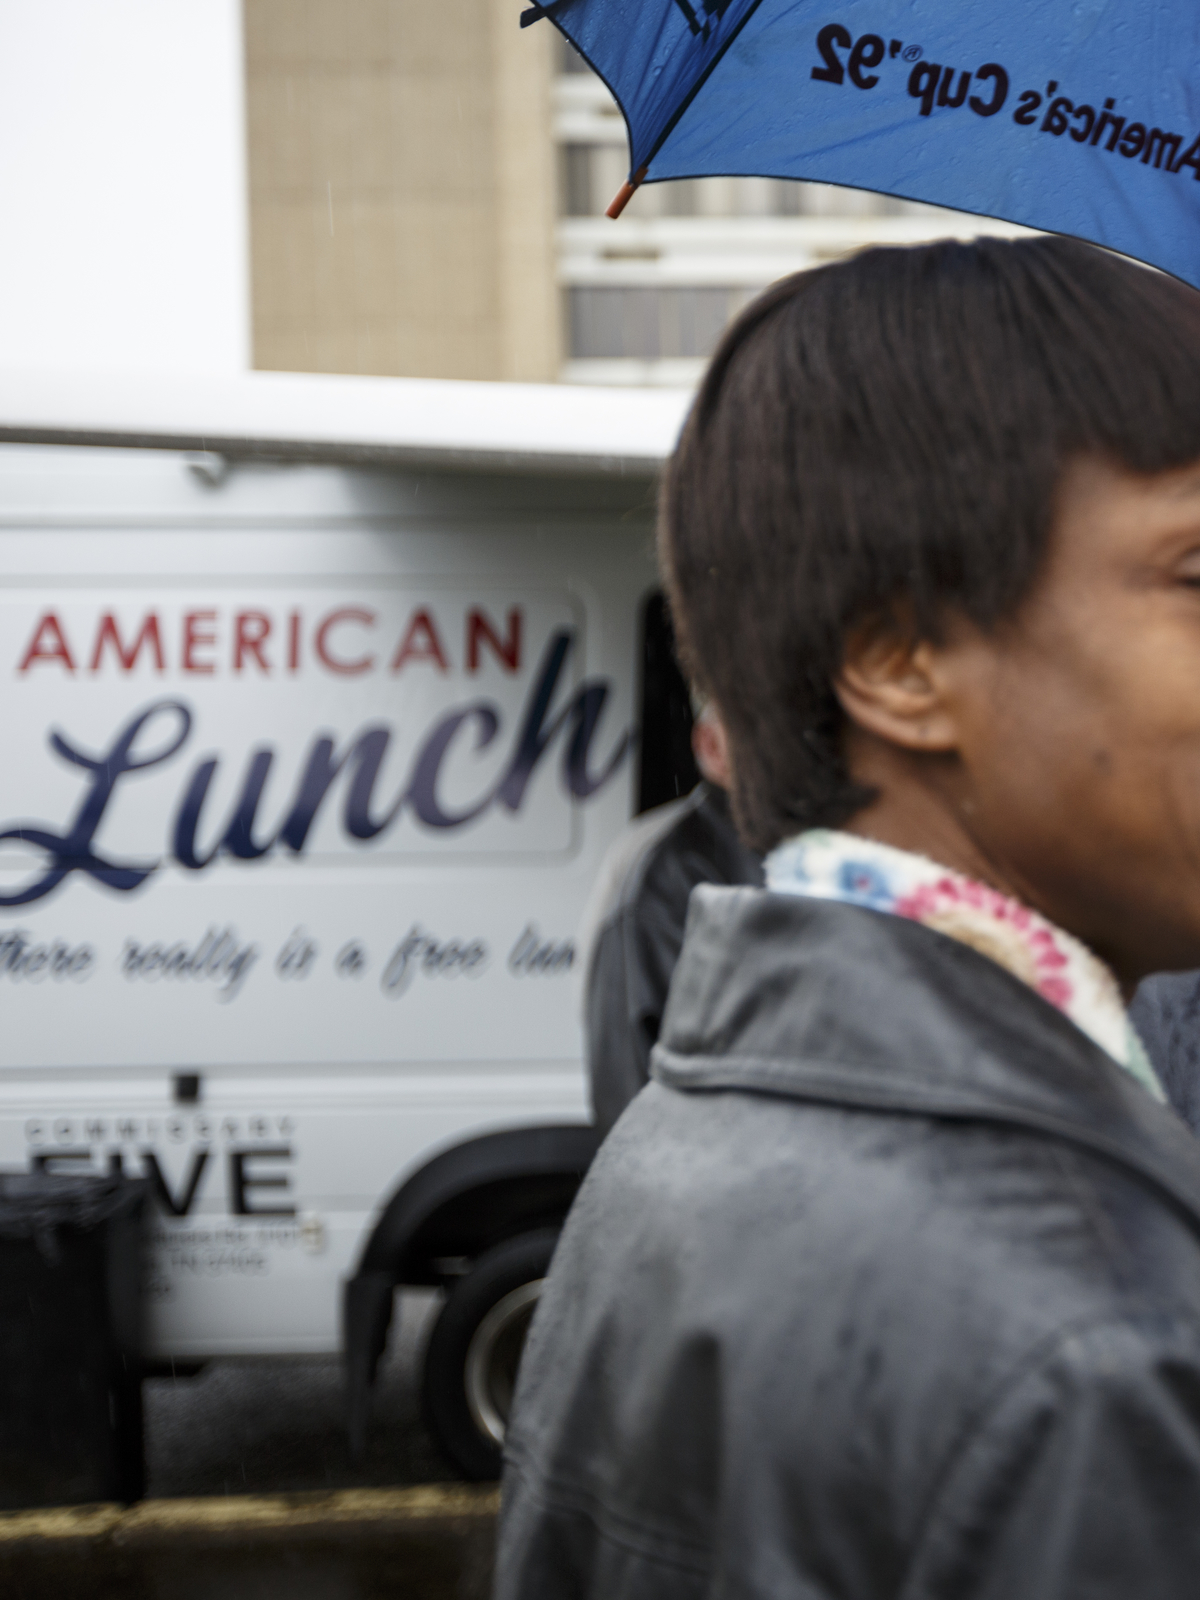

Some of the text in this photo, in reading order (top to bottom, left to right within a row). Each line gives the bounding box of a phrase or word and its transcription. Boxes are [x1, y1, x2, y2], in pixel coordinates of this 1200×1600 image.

[17, 607, 525, 677] AMERICAN
[0, 627, 637, 906] Lunch
[119, 923, 257, 1002] really
[275, 926, 318, 980] is
[335, 938, 369, 978] a
[380, 922, 488, 999] free
